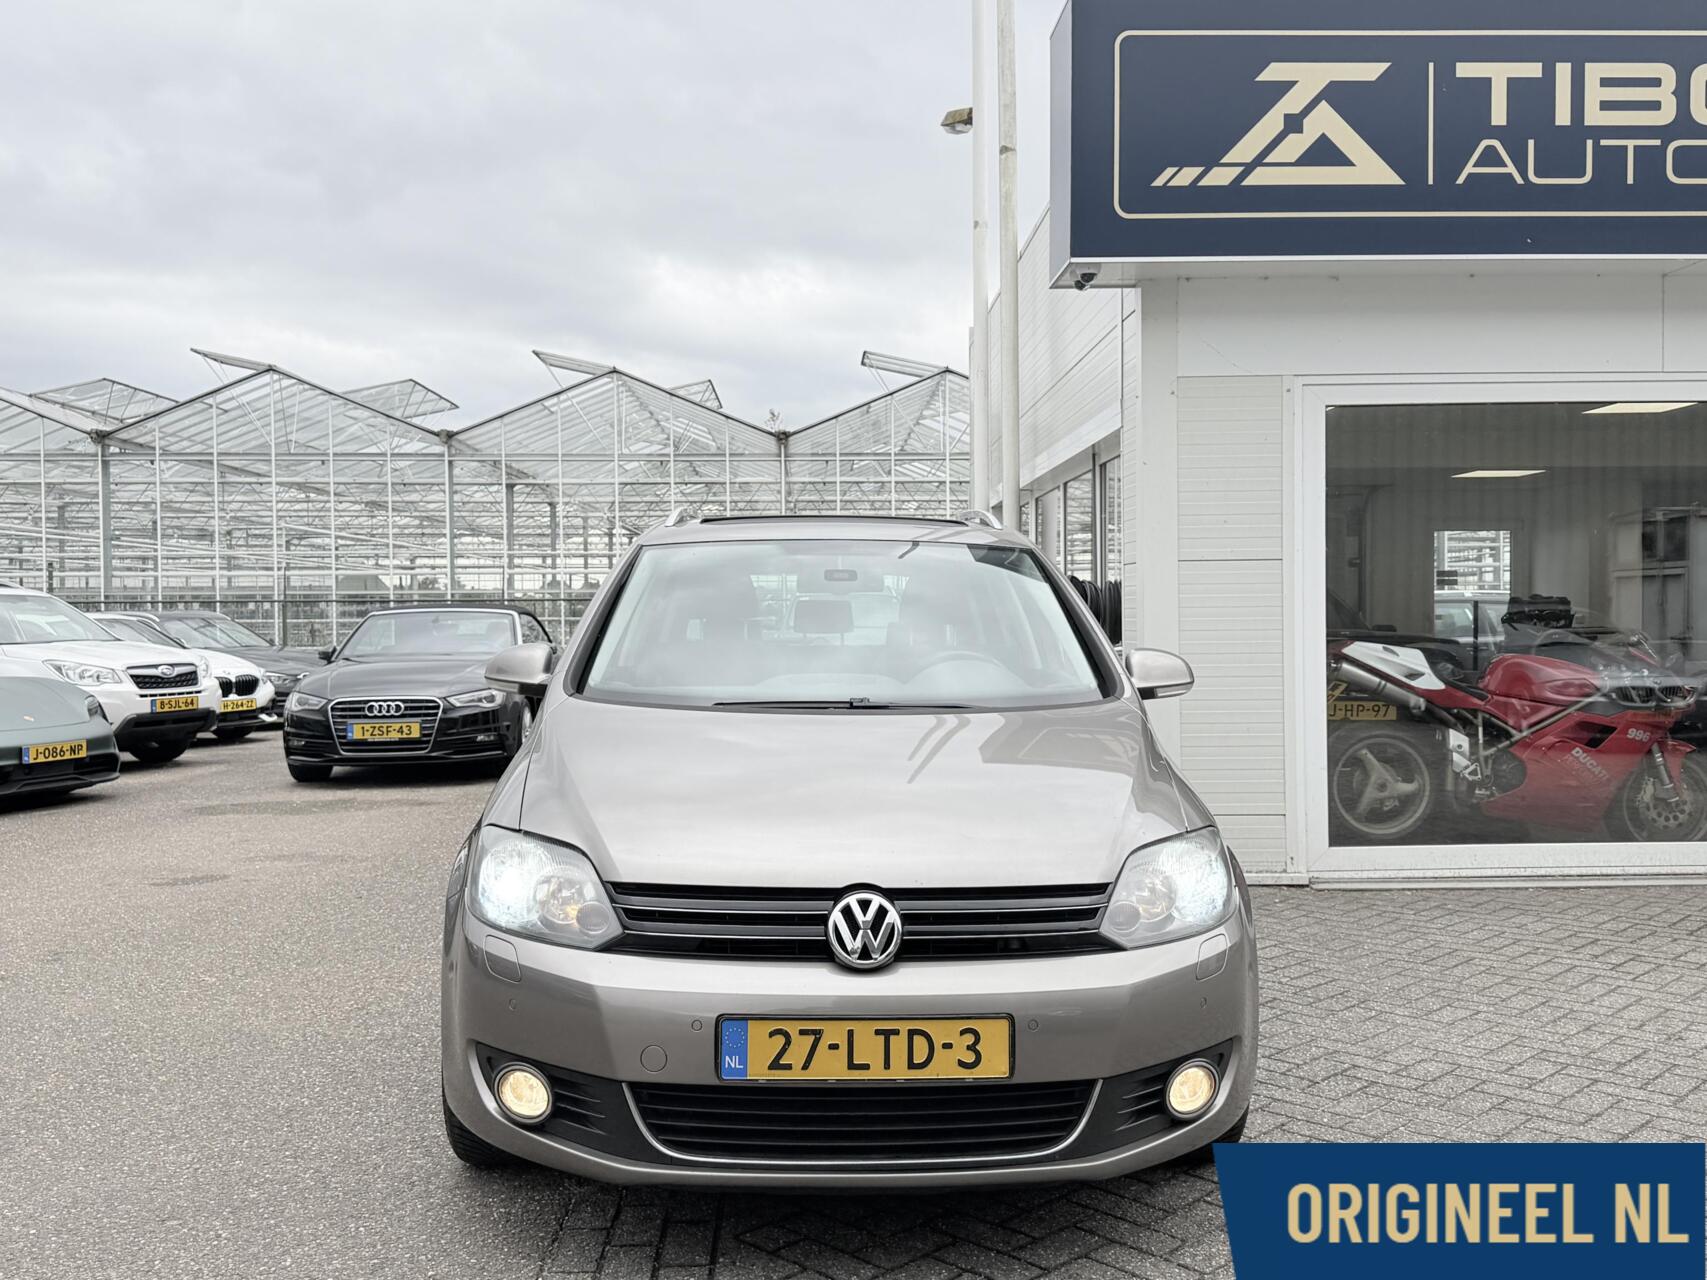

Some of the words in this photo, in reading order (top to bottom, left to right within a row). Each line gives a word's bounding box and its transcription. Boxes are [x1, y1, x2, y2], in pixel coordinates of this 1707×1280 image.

[1455, 61, 1707, 126] TIB
[160, 698, 195, 710] 8-SJL-64
[223, 700, 254, 711] H-264-ZZ
[361, 724, 413, 737] 1-ZSF-43
[1626, 727, 1652, 743] 996
[33, 743, 84, 761] J-086-NP
[1571, 746, 1609, 780] DUCATI
[725, 1055, 744, 1069] NL
[767, 1026, 983, 1071] 27-LTD-3
